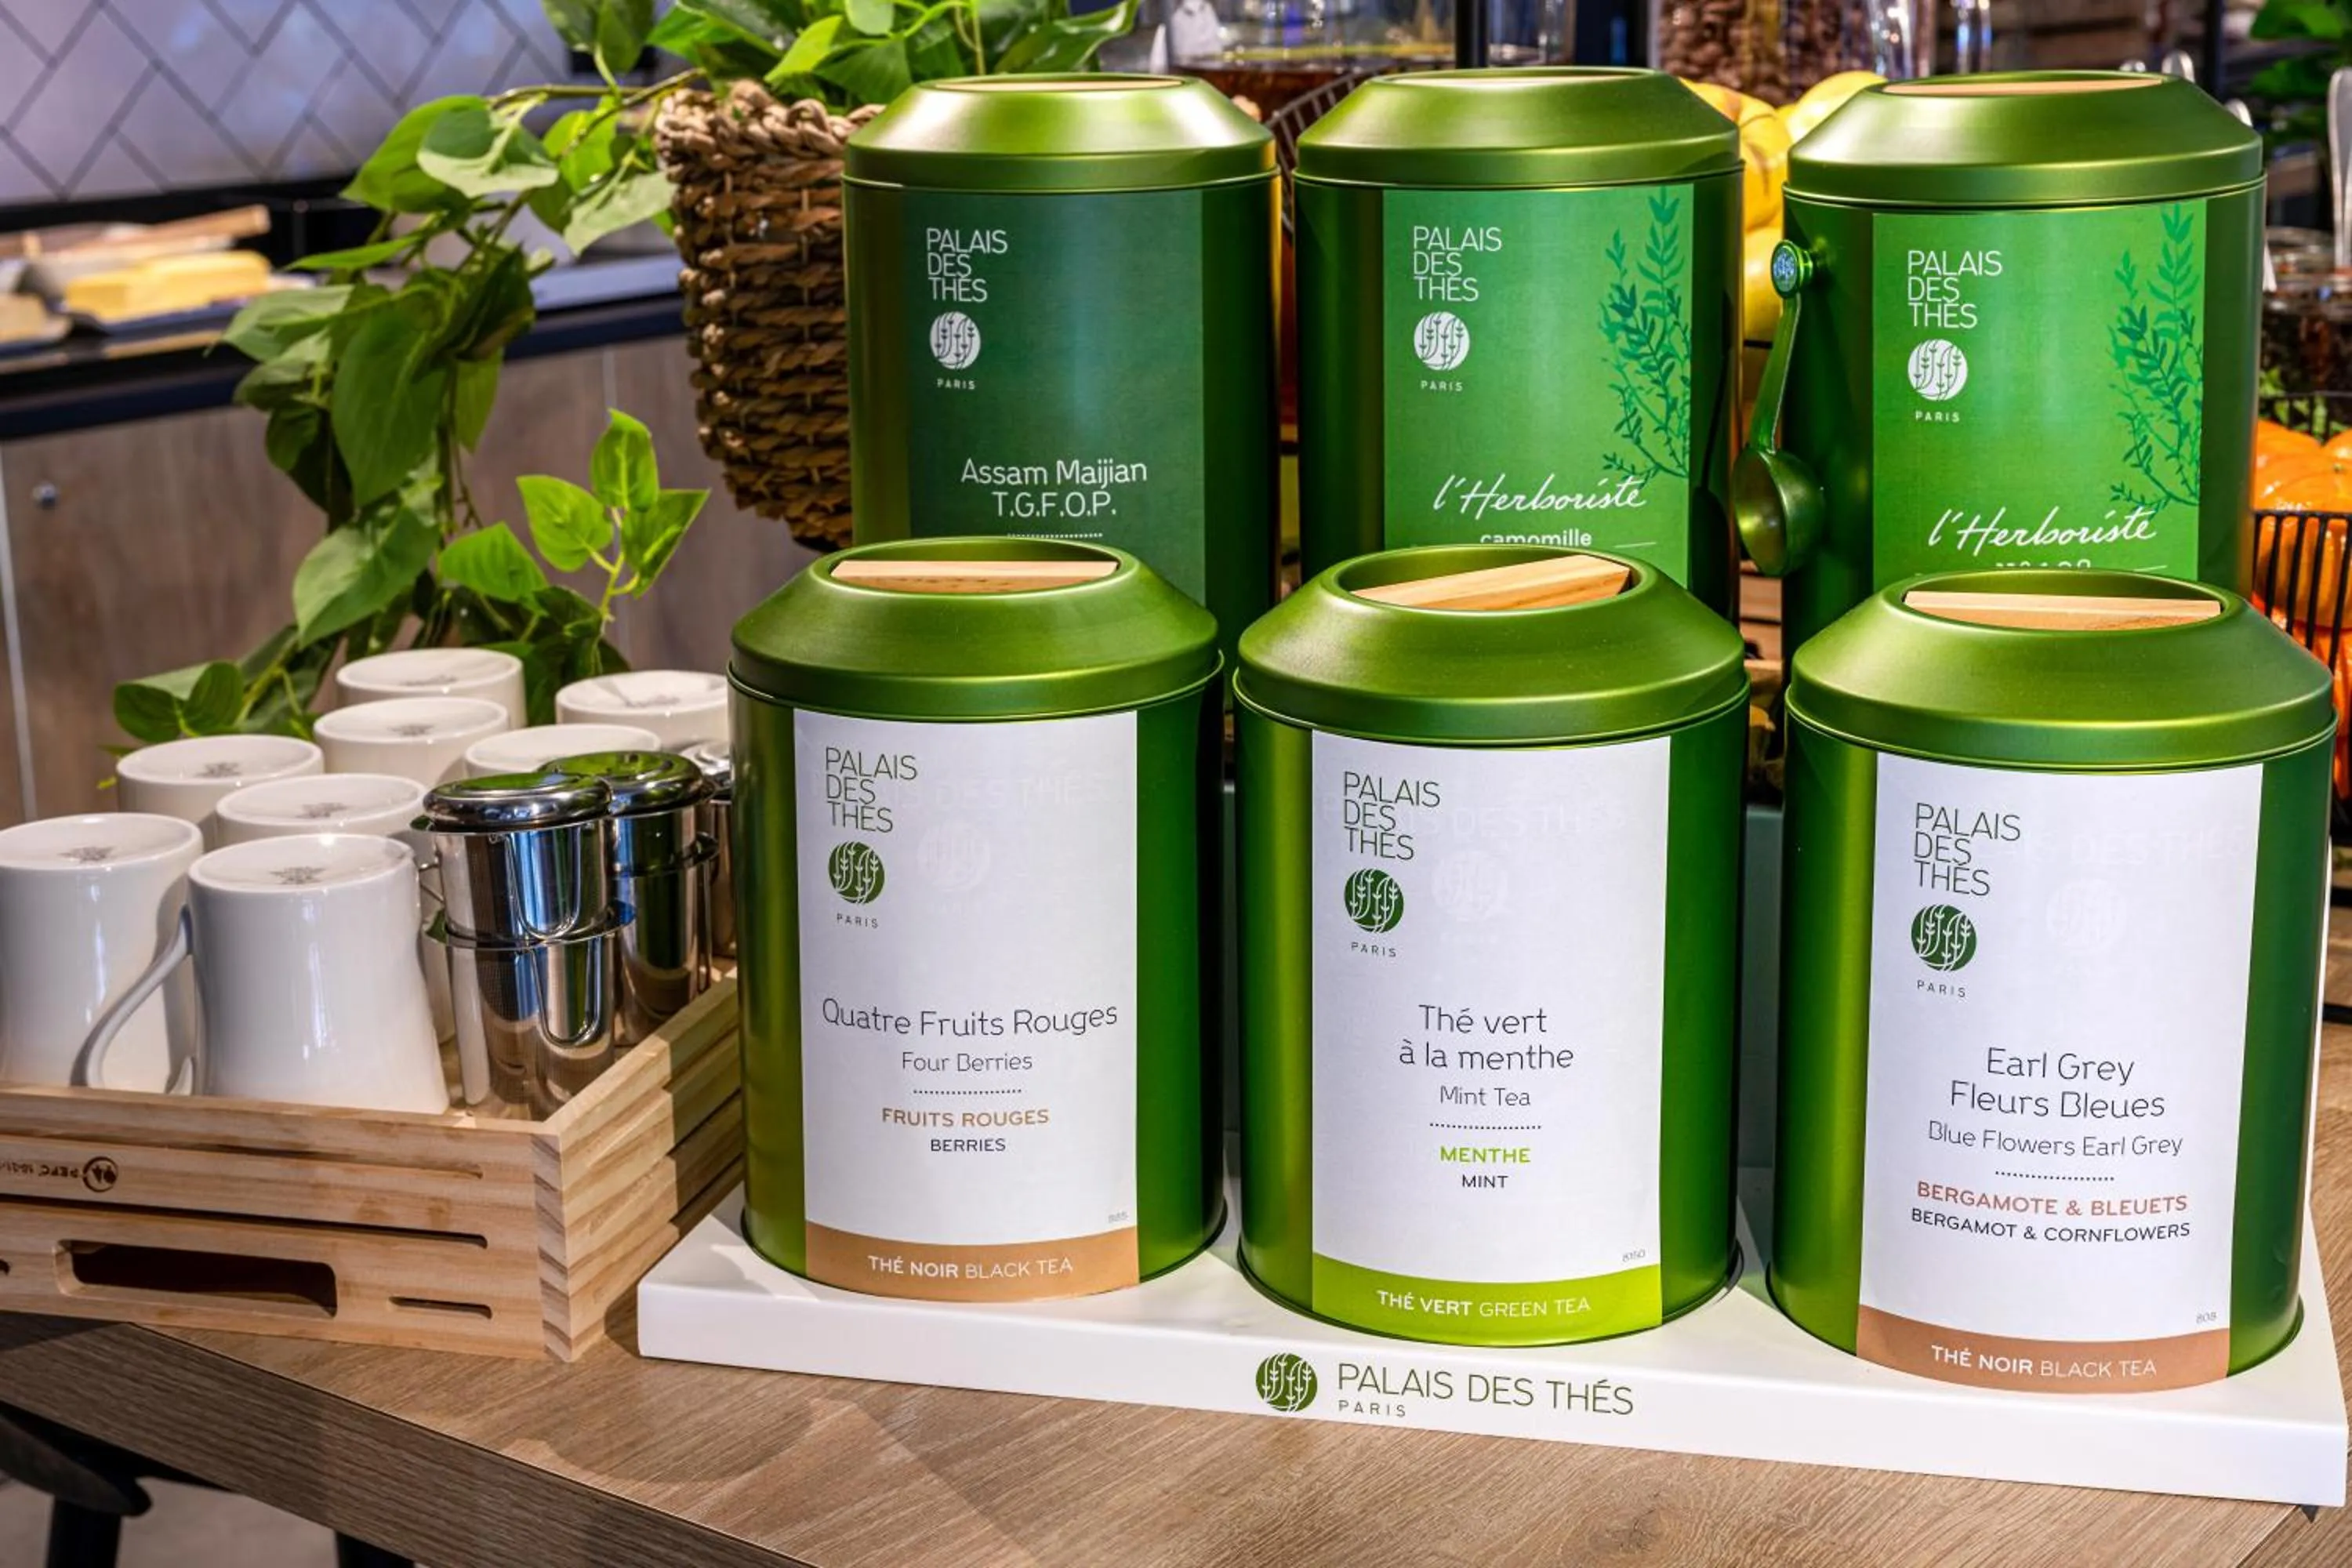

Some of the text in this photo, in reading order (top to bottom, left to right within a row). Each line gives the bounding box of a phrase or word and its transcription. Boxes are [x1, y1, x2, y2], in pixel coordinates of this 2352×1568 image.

[926, 228, 1008, 254] PALAIS
[1413, 226, 1503, 252] PALAIS
[927, 253, 971, 278] DES
[1413, 252, 1462, 276] DES
[1907, 250, 2003, 276] PALAIS
[1907, 277, 1959, 302] DES
[937, 379, 975, 390] PARIS
[1421, 380, 1463, 391] PARIS
[1915, 411, 1960, 423] PARIS
[960, 457, 1148, 489] Assam Maijian
[992, 492, 1117, 517] T.G.F.O.P.
[1480, 530, 1592, 546] camomille
[826, 746, 918, 780] PALAIS
[826, 775, 876, 804] DES
[1344, 771, 1440, 808] PALAIS
[1345, 799, 1396, 829] DES
[1915, 802, 2021, 841] PALAIS
[1914, 831, 1971, 865] DES
[837, 913, 879, 928] PARIS
[1351, 942, 1396, 957] PARIS
[1917, 979, 1966, 998] PARIS
[822, 998, 1117, 1036] Quatre Fruits Rouges
[1418, 1004, 1547, 1034] Thé vert
[902, 1051, 1033, 1072] Four Berries
[1399, 1039, 1573, 1071] à la menthe
[1987, 1047, 2135, 1086] Earl Grey
[1439, 1085, 1530, 1106] Mint Tea
[1951, 1080, 2165, 1118] Fleurs Bleues
[882, 1108, 1050, 1127] FRUITS ROUGES
[931, 1138, 1006, 1152] BERRIES
[1929, 1120, 2183, 1156] Blue Flowers Earl Grey
[1440, 1146, 1530, 1163] MENTHE
[1462, 1174, 1508, 1189] MINT
[1918, 1181, 2187, 1217] BERGAMOTE & BLEUETS
[1911, 1208, 2190, 1242] BERGAMOT & CORNFLOWERS
[868, 1255, 1073, 1279] THÉ NOIR BLACK TEA
[1377, 1290, 1592, 1317] THÉ VERT GREEN TEA
[1931, 1345, 2157, 1377] THÉ NOIR BLACK TEA
[1338, 1363, 1634, 1416] PALAIS DES THÉS
[1338, 1399, 1406, 1417] PARIS
